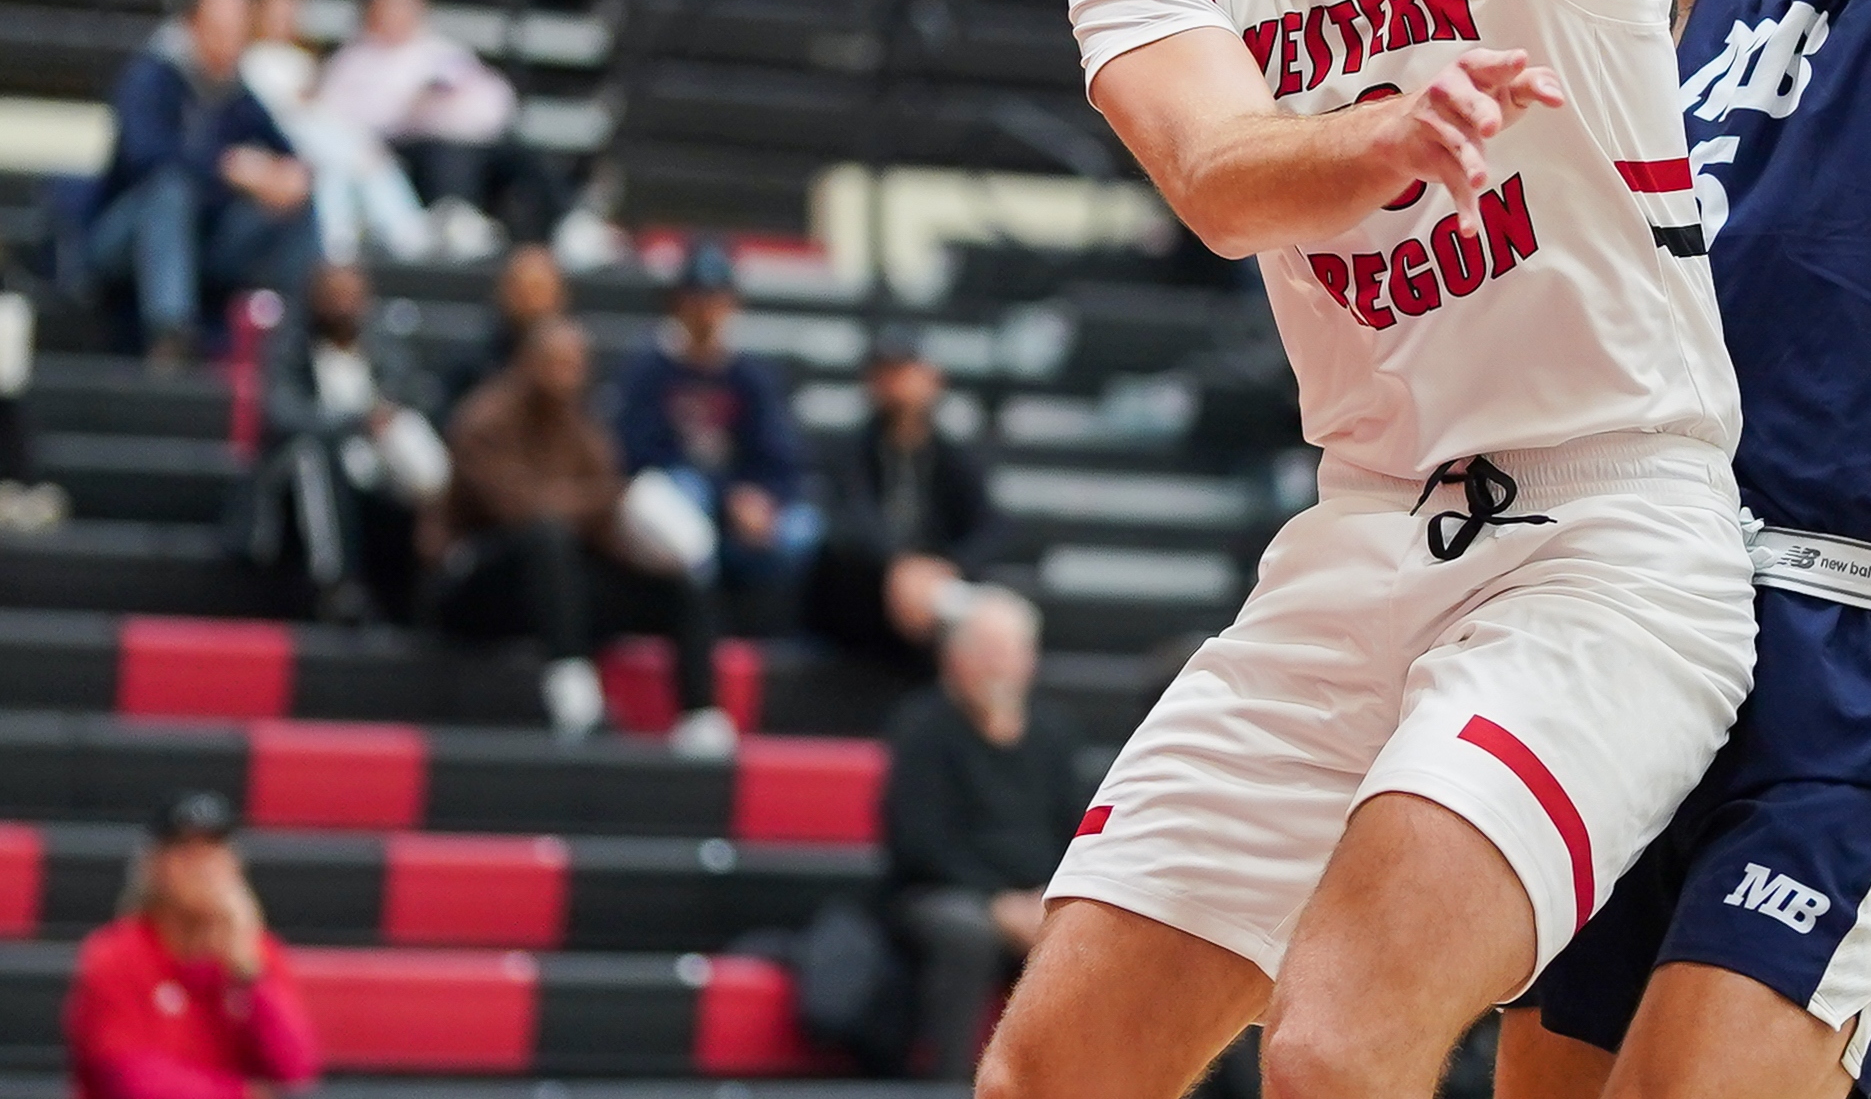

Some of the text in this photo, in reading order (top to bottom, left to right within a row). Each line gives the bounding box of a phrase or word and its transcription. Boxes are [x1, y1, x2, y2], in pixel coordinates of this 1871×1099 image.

[1679, 0, 1830, 122] MB
[1302, 171, 1539, 331] REGON
[1820, 557, 1848, 573] new
[1723, 862, 1831, 934] MB
